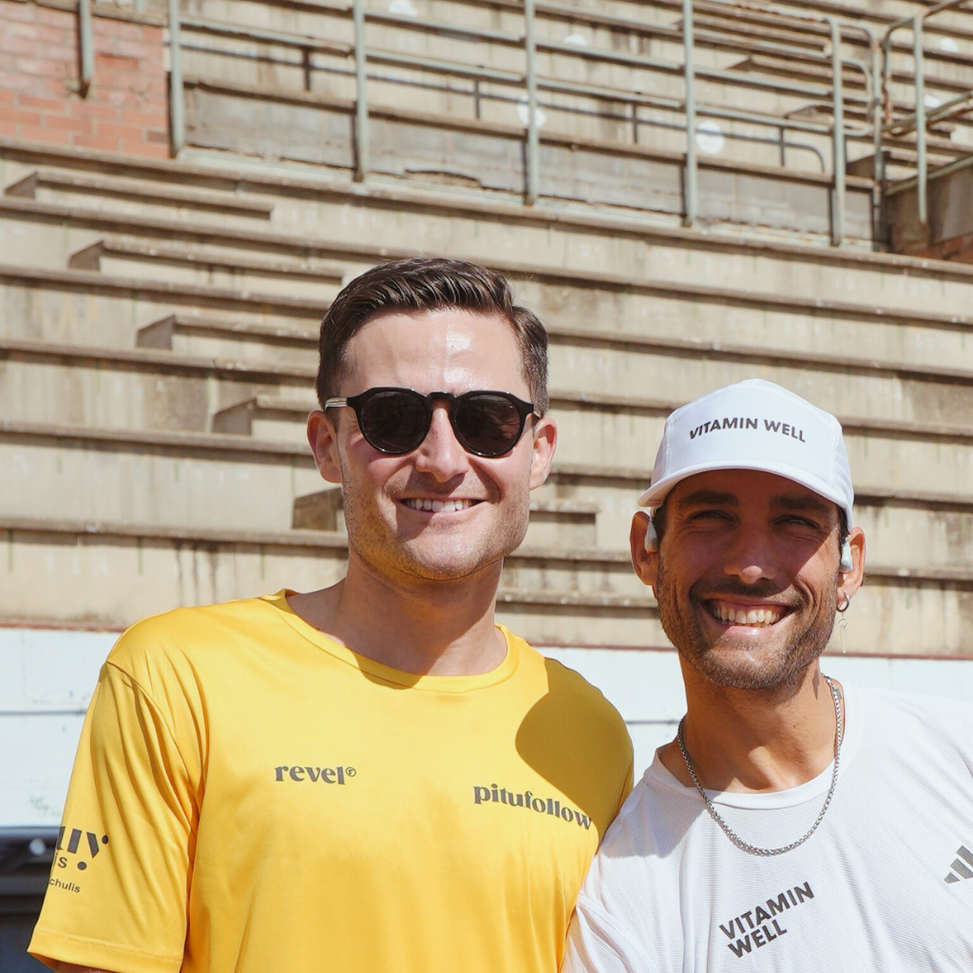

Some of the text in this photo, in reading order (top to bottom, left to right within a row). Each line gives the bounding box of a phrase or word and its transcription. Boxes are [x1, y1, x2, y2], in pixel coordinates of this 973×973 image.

[689, 417, 806, 443] VITAMIN WELL
[473, 783, 592, 830] pitufollow
[719, 881, 815, 940] VITAMIN
[727, 919, 788, 958] WELL
